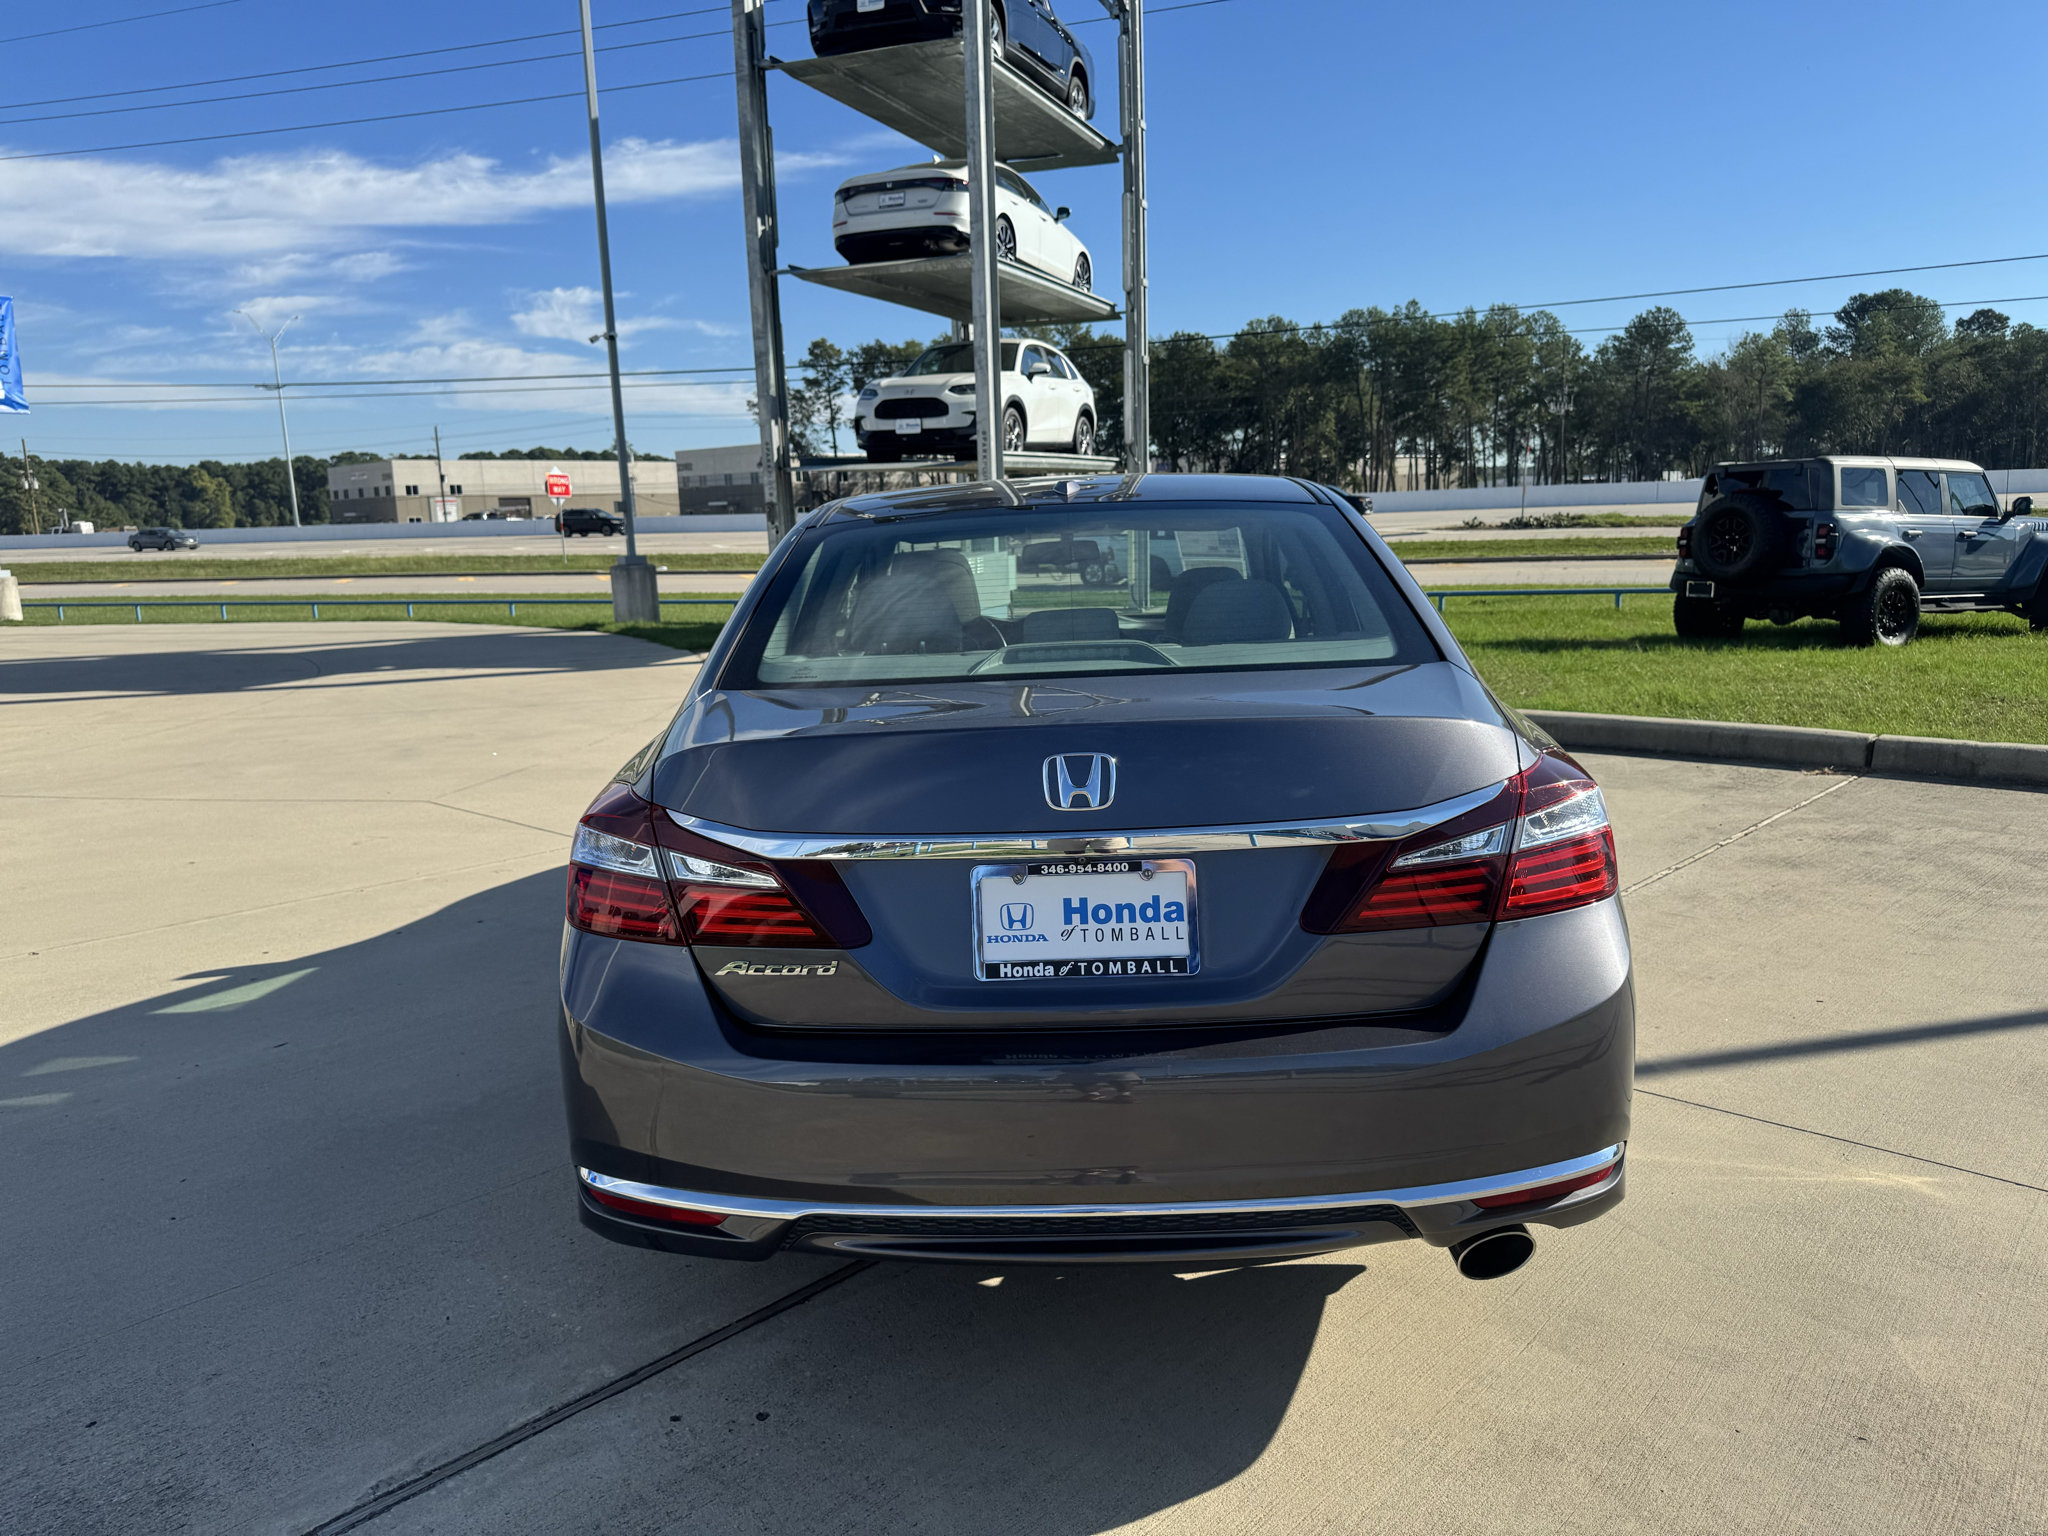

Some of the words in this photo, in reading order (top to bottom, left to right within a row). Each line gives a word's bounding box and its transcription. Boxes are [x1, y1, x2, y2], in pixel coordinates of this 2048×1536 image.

[1041, 862, 1129, 874] 346-954-8400
[1062, 895, 1185, 926] Honda
[986, 934, 1049, 944] HONDA
[1060, 925, 1079, 942] of
[1079, 926, 1185, 943] TOMBALL
[714, 960, 838, 976] Accord
[1000, 963, 1055, 978] Honda
[1058, 962, 1075, 976] of
[1078, 960, 1179, 975] TOMBALL
